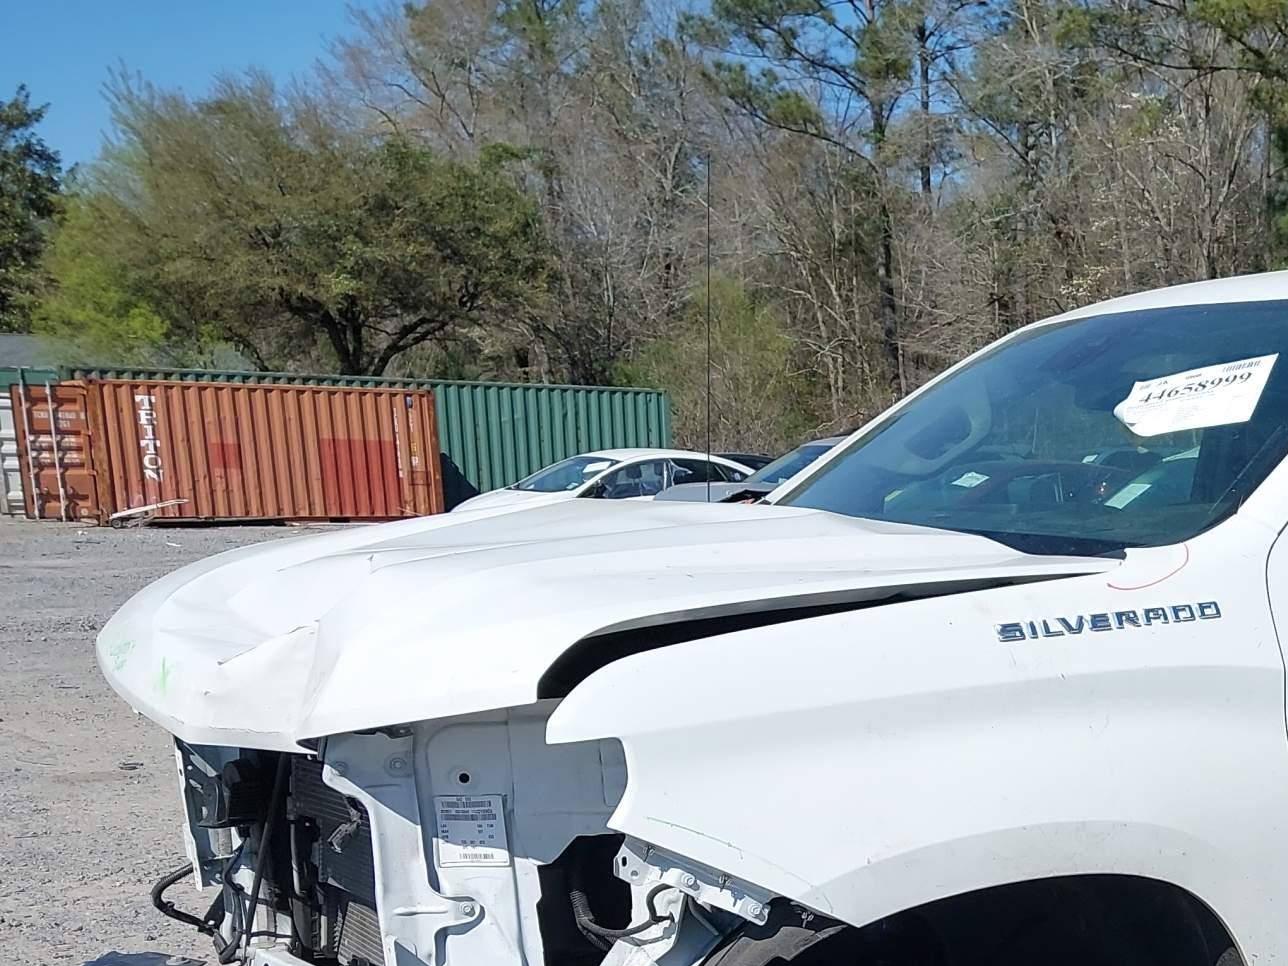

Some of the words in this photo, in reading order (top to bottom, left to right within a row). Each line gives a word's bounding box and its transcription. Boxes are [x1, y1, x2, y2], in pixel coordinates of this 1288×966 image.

[1138, 371, 1252, 403] 44658999
[134, 394, 163, 481] TRITON
[996, 601, 1222, 642] SILVERADO
